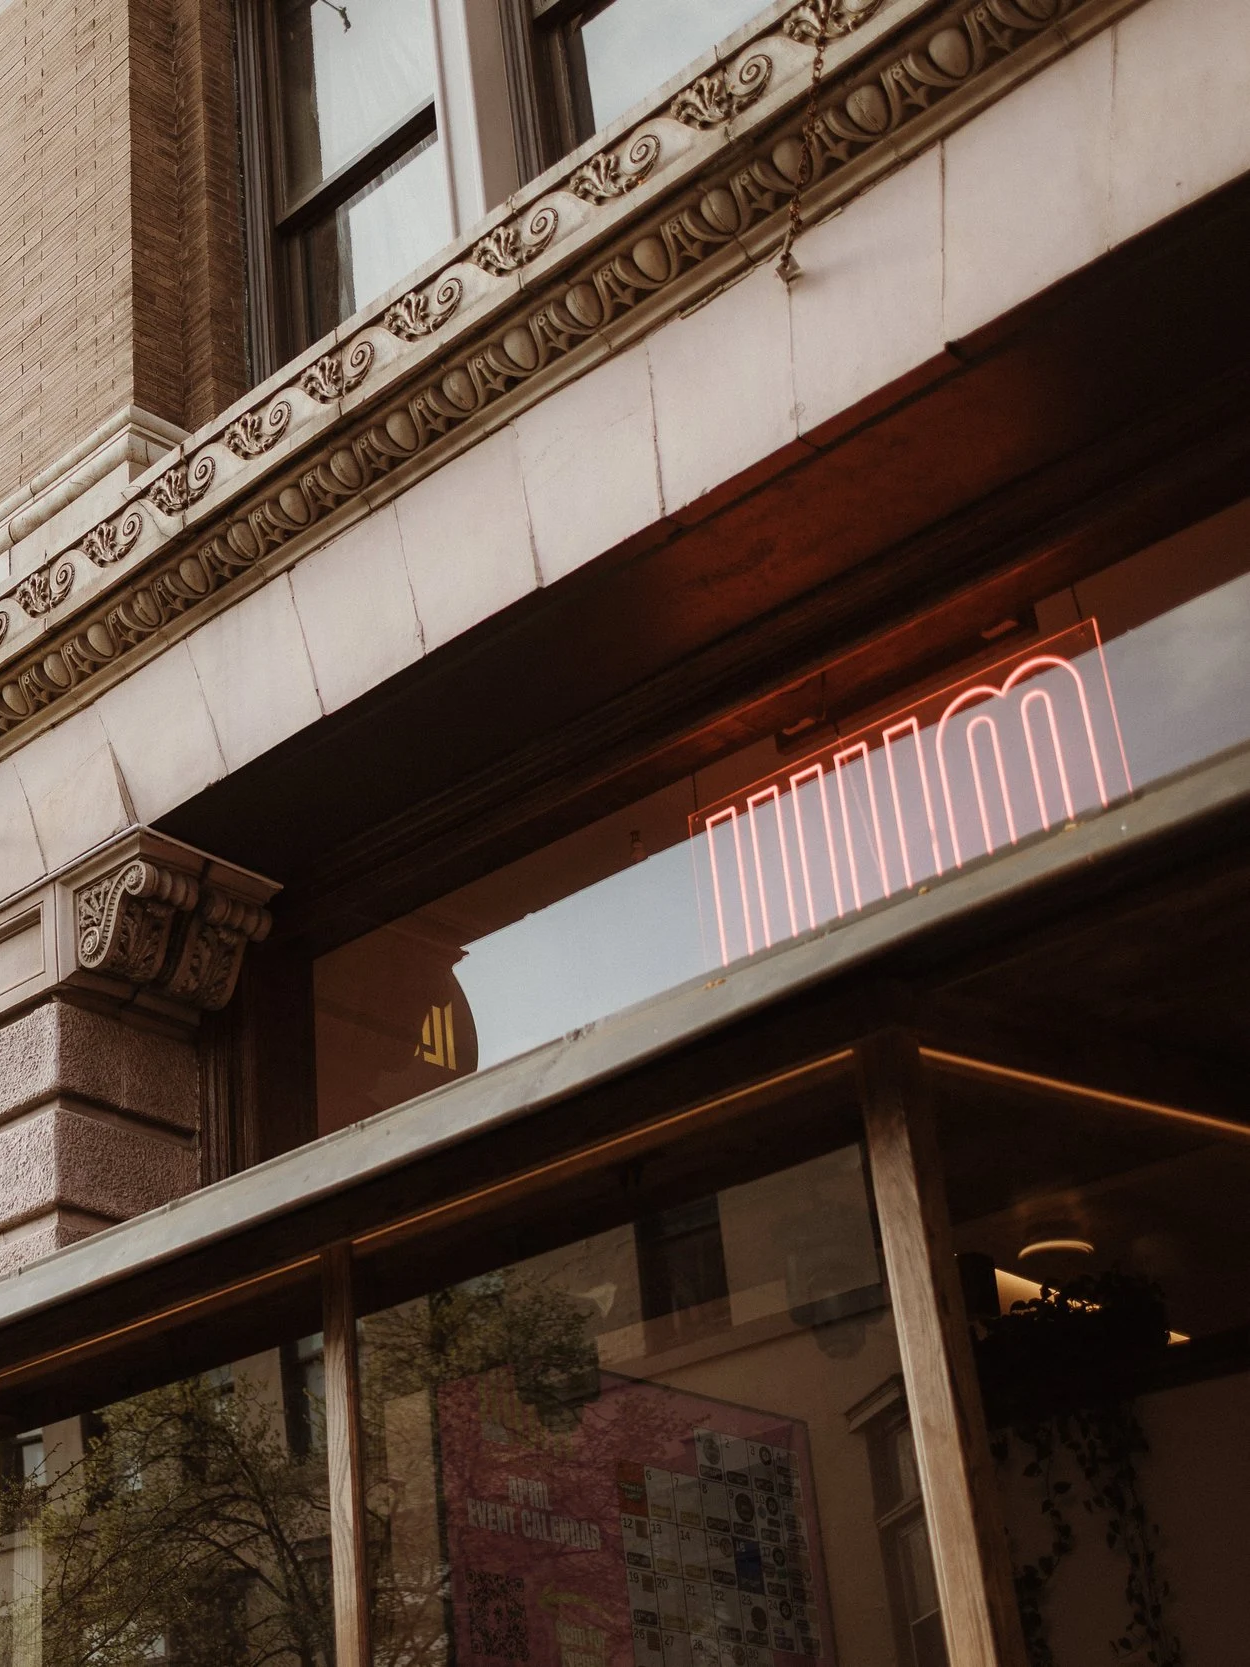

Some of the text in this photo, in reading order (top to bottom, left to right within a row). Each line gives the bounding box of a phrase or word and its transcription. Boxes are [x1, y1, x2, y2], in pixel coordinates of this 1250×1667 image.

[508, 1475, 553, 1511] APRIL
[645, 1470, 652, 1480] 6
[702, 1483, 708, 1494] 8
[728, 1488, 734, 1499] 9
[755, 1493, 765, 1504] 10
[467, 1497, 601, 1552] EVENT CALENDAR
[622, 1518, 633, 1529] 12
[651, 1523, 662, 1534] 13
[680, 1530, 691, 1540] 14
[708, 1536, 719, 1547] 15
[736, 1541, 746, 1552] 16
[629, 1572, 639, 1583] 19
[656, 1578, 669, 1590] 20
[686, 1584, 695, 1596] 21
[714, 1590, 725, 1602] 22
[741, 1594, 752, 1605] 23
[768, 1600, 778, 1611] 24
[634, 1628, 645, 1640] 26
[664, 1635, 674, 1646] 27
[693, 1639, 704, 1650] 28
